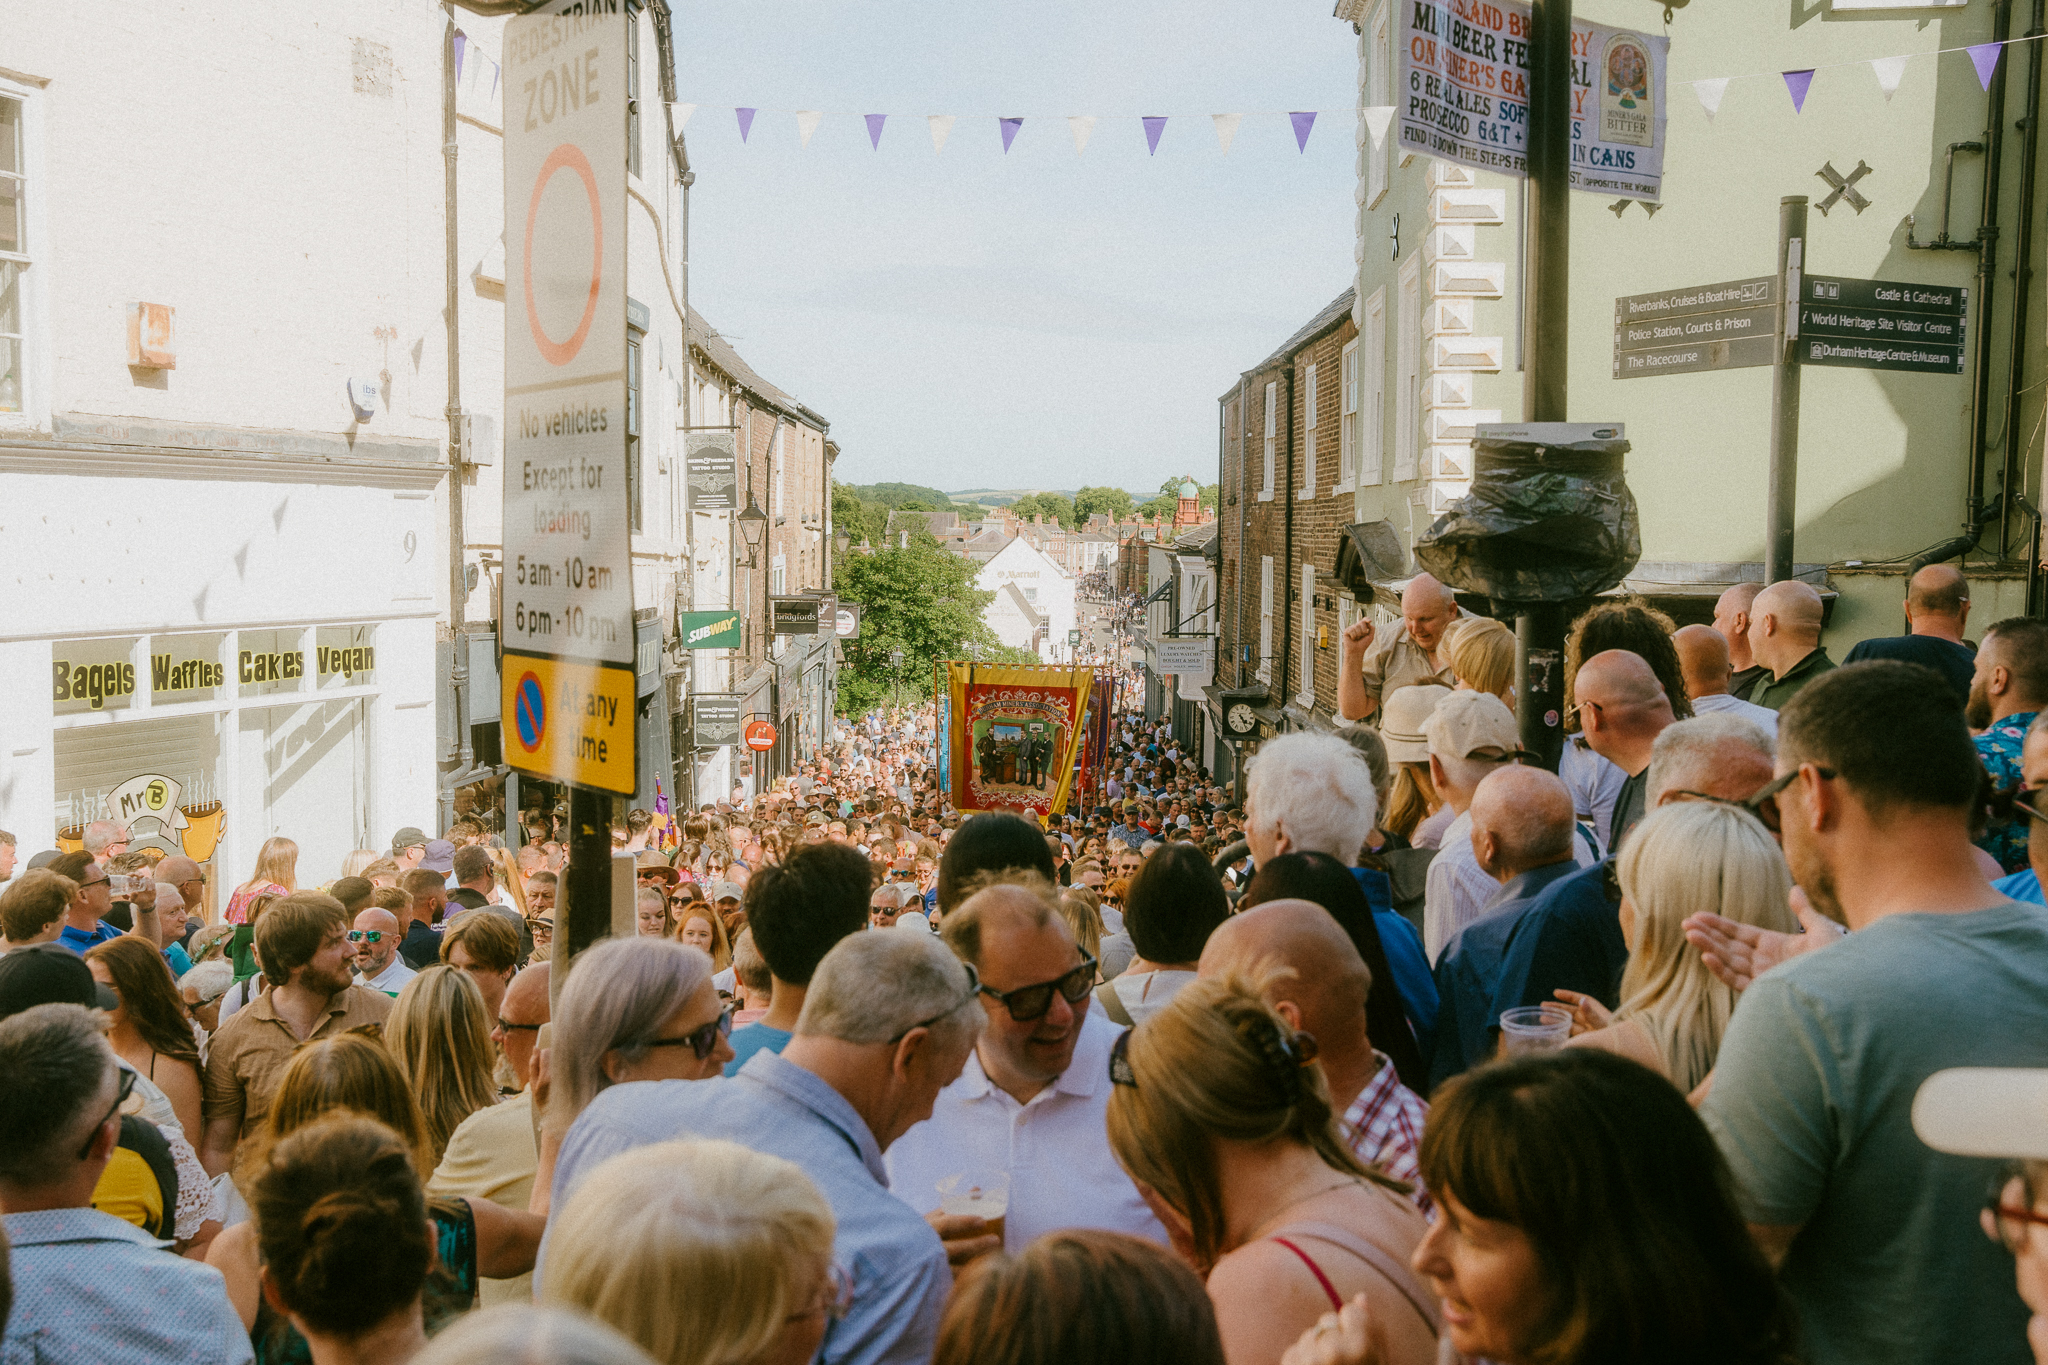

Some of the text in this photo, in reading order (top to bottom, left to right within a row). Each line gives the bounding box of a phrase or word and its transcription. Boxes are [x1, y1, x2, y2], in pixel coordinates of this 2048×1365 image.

[510, 0, 617, 70] PEDESTRIAN
[1411, 36, 1437, 67] ON
[1453, 20, 1498, 63] BEER
[524, 46, 599, 133] ZONE
[1410, 70, 1420, 92] 6
[1456, 90, 1491, 117] ALES
[1410, 95, 1470, 136] PROSECCO
[1478, 120, 1511, 145] G&T
[1573, 143, 1587, 164] IN
[1590, 146, 1636, 170] CANS
[1607, 118, 1647, 134] BITTER
[1404, 126, 1427, 144] FIND
[1428, 132, 1438, 149] US
[1438, 137, 1459, 157] DOWN
[1459, 144, 1478, 162] THE
[1480, 150, 1512, 169] STEPS
[1620, 181, 1634, 191] THE
[1629, 288, 1741, 314] Riverbanks, Cruises & Boat Hire
[1875, 287, 1952, 306] Castle & Cathedral
[1628, 317, 1752, 342] Police Station, Courts & Prison
[1811, 312, 1952, 335] World Heritage Site Visitor Centre
[1627, 351, 1698, 368] The Racecourse
[1823, 344, 1951, 364] Durham Heritage Centre & Museum
[362, 384, 377, 395] ibs
[520, 401, 608, 439] No vehicles
[523, 457, 604, 496] Except for
[534, 501, 592, 541] loading
[403, 529, 417, 565] 9
[517, 555, 526, 585] 5
[530, 563, 551, 587] am
[565, 557, 583, 589] 10
[588, 565, 613, 591] am
[1006, 570, 1040, 579] Marriott
[516, 602, 525, 632] 6
[529, 609, 551, 638] pm
[565, 605, 584, 637] 10
[589, 615, 616, 645] pm
[687, 616, 738, 644] SUBWAY
[150, 653, 225, 692] Waffles
[239, 650, 305, 684] Cakes
[316, 645, 376, 680] Vegan
[52, 659, 136, 710] Bagels
[559, 680, 618, 727] At any
[1025, 700, 1061, 718] ASSOCIATION
[569, 726, 608, 763] time
[120, 784, 164, 819] Mr B
